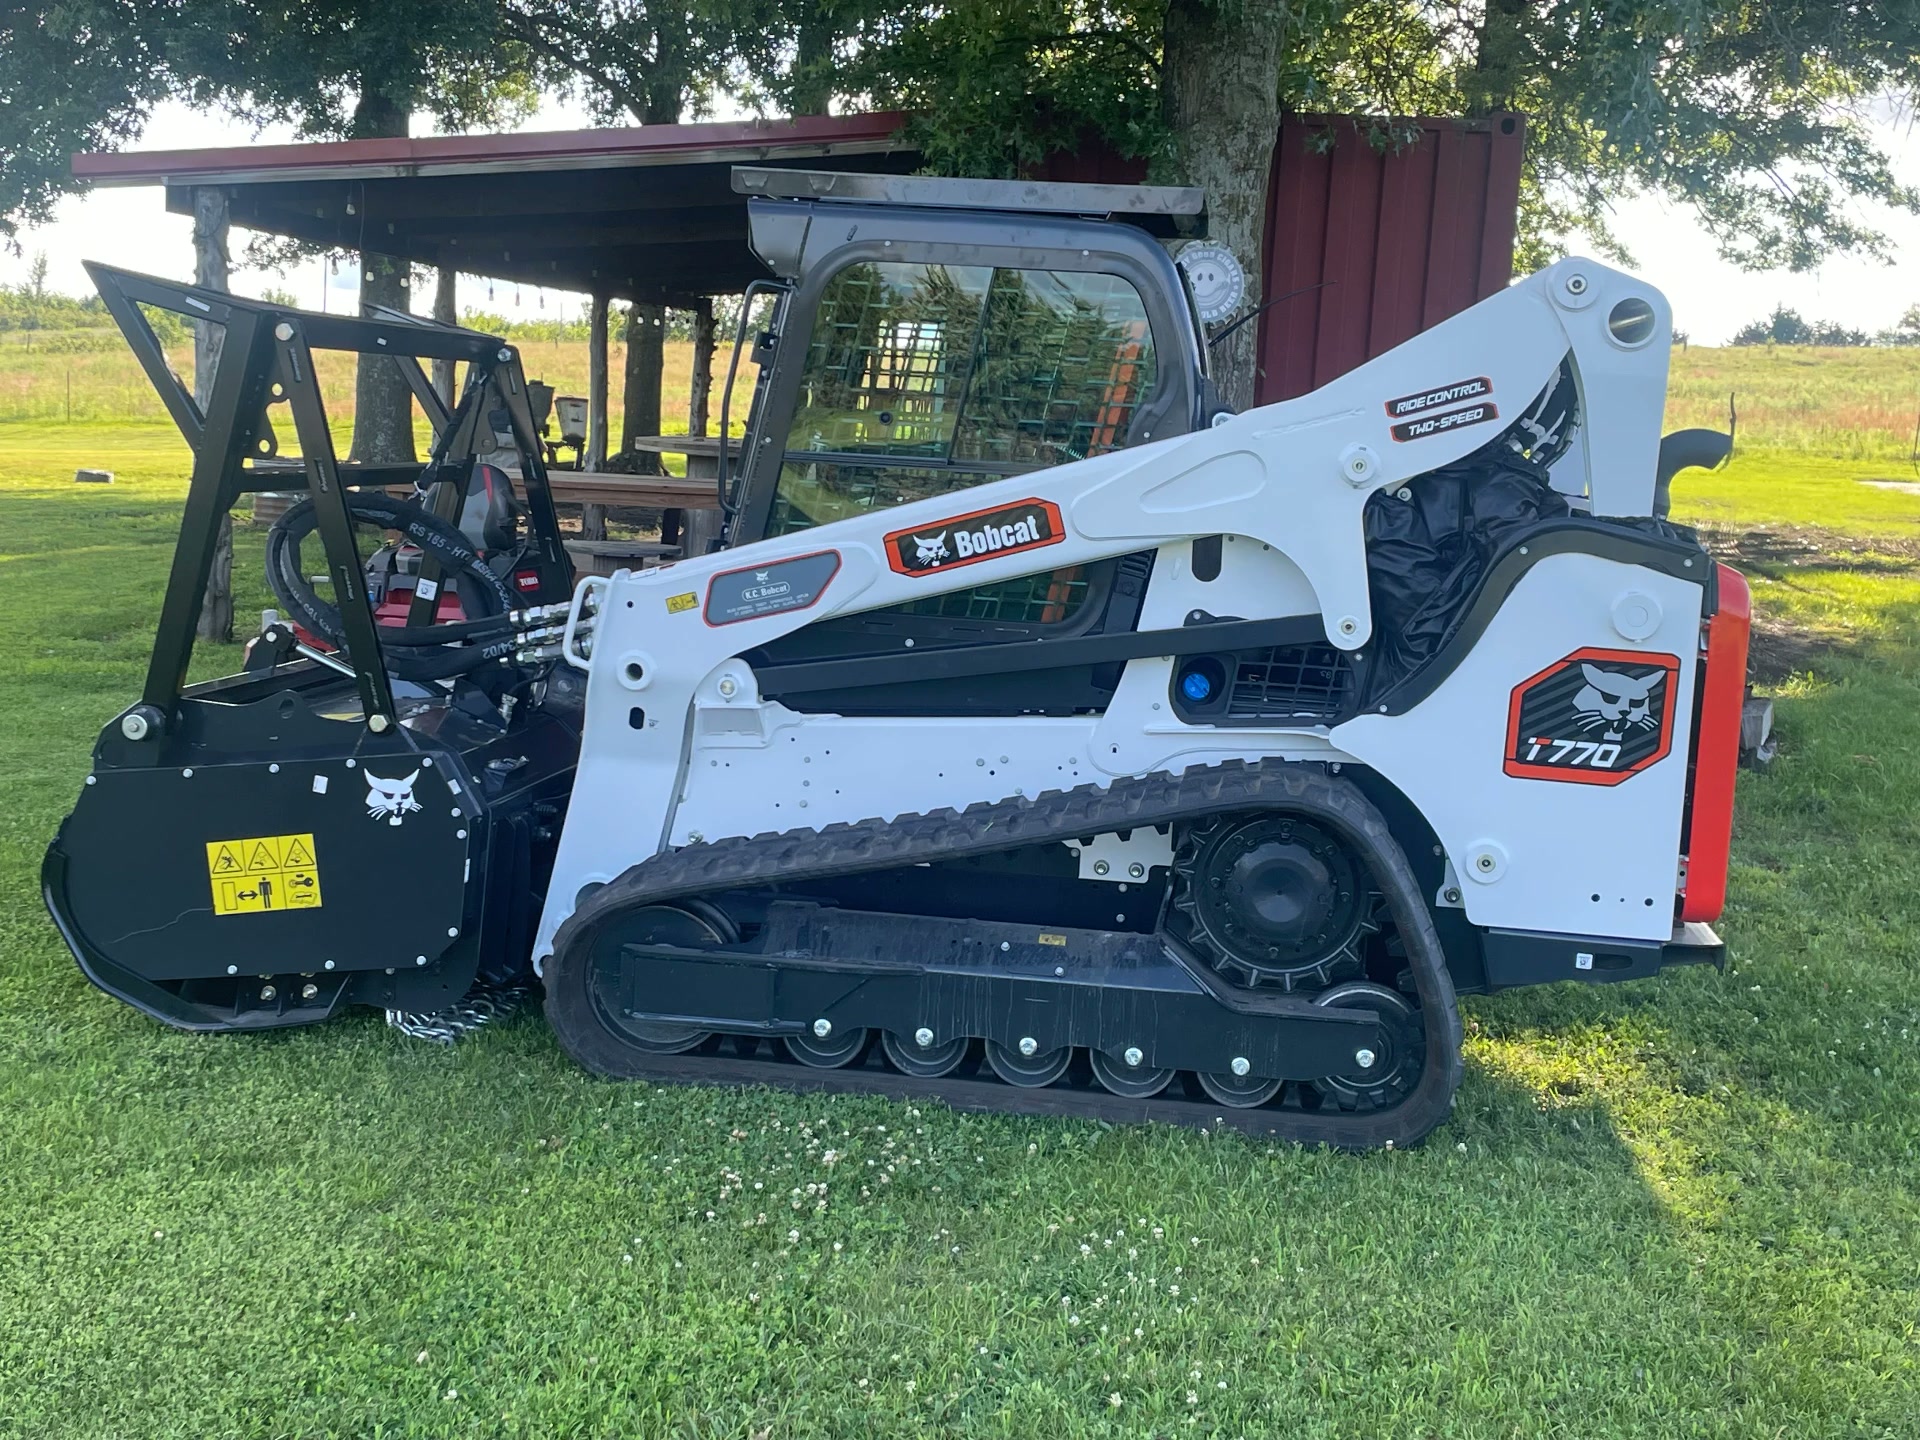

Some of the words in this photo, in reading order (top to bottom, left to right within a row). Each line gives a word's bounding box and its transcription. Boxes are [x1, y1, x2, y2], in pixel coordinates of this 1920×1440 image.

[1397, 397, 1426, 413] RIDE
[1426, 382, 1485, 405] CONTROL
[1409, 408, 1484, 436] TWO-SPEED
[954, 515, 1040, 558] Bobcat
[761, 585, 787, 596] Bobcat
[1526, 737, 1621, 768] T770
